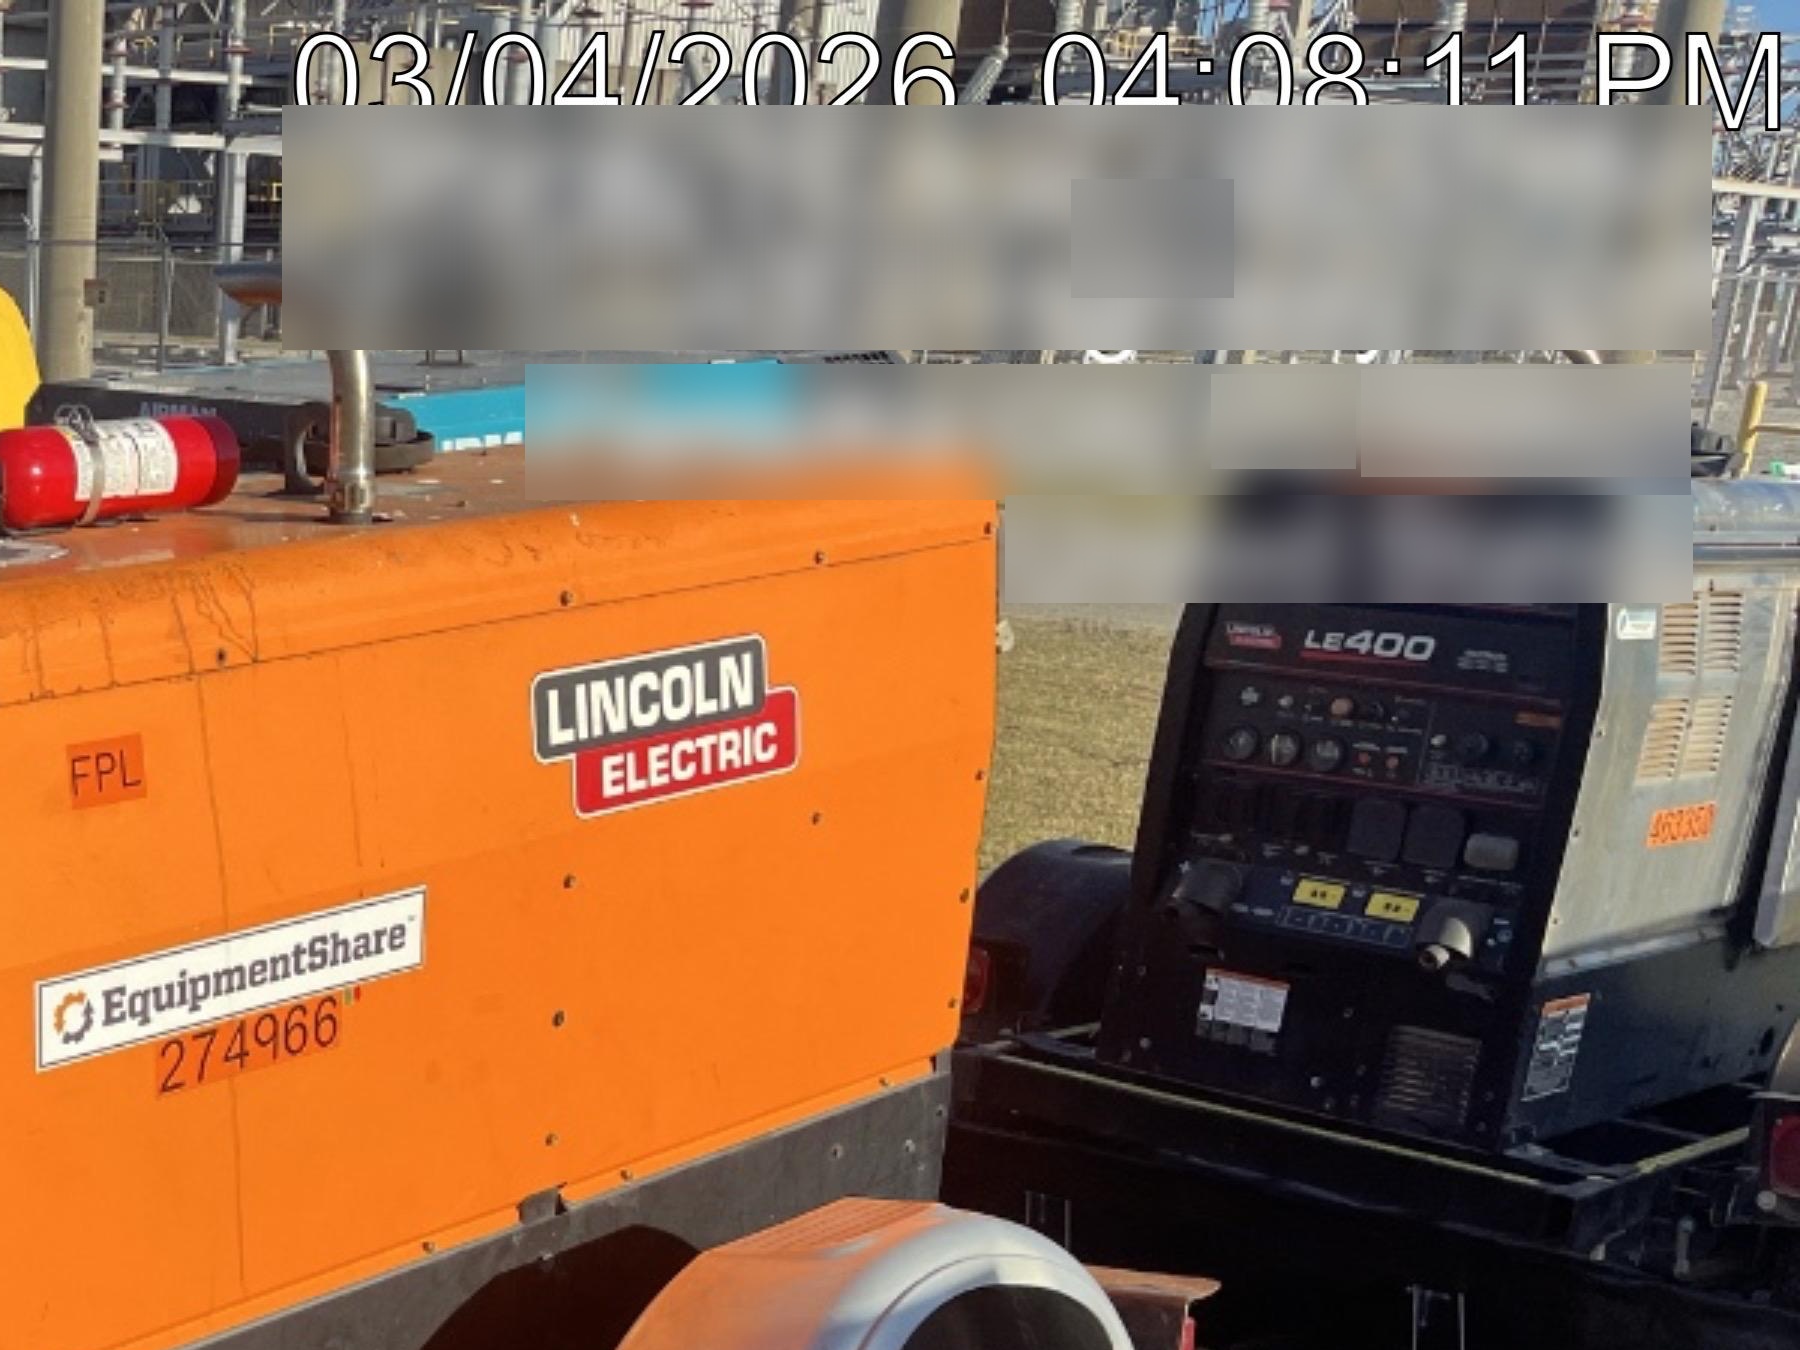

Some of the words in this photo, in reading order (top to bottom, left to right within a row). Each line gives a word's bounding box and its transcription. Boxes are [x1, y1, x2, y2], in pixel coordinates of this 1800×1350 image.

[1303, 629, 1436, 661] LE400
[546, 650, 756, 747] LINCOLN
[69, 747, 143, 798] FPL
[600, 721, 780, 799] ELECTRIC
[101, 918, 408, 1028] EquipmentShare
[158, 995, 340, 1095] 274966
